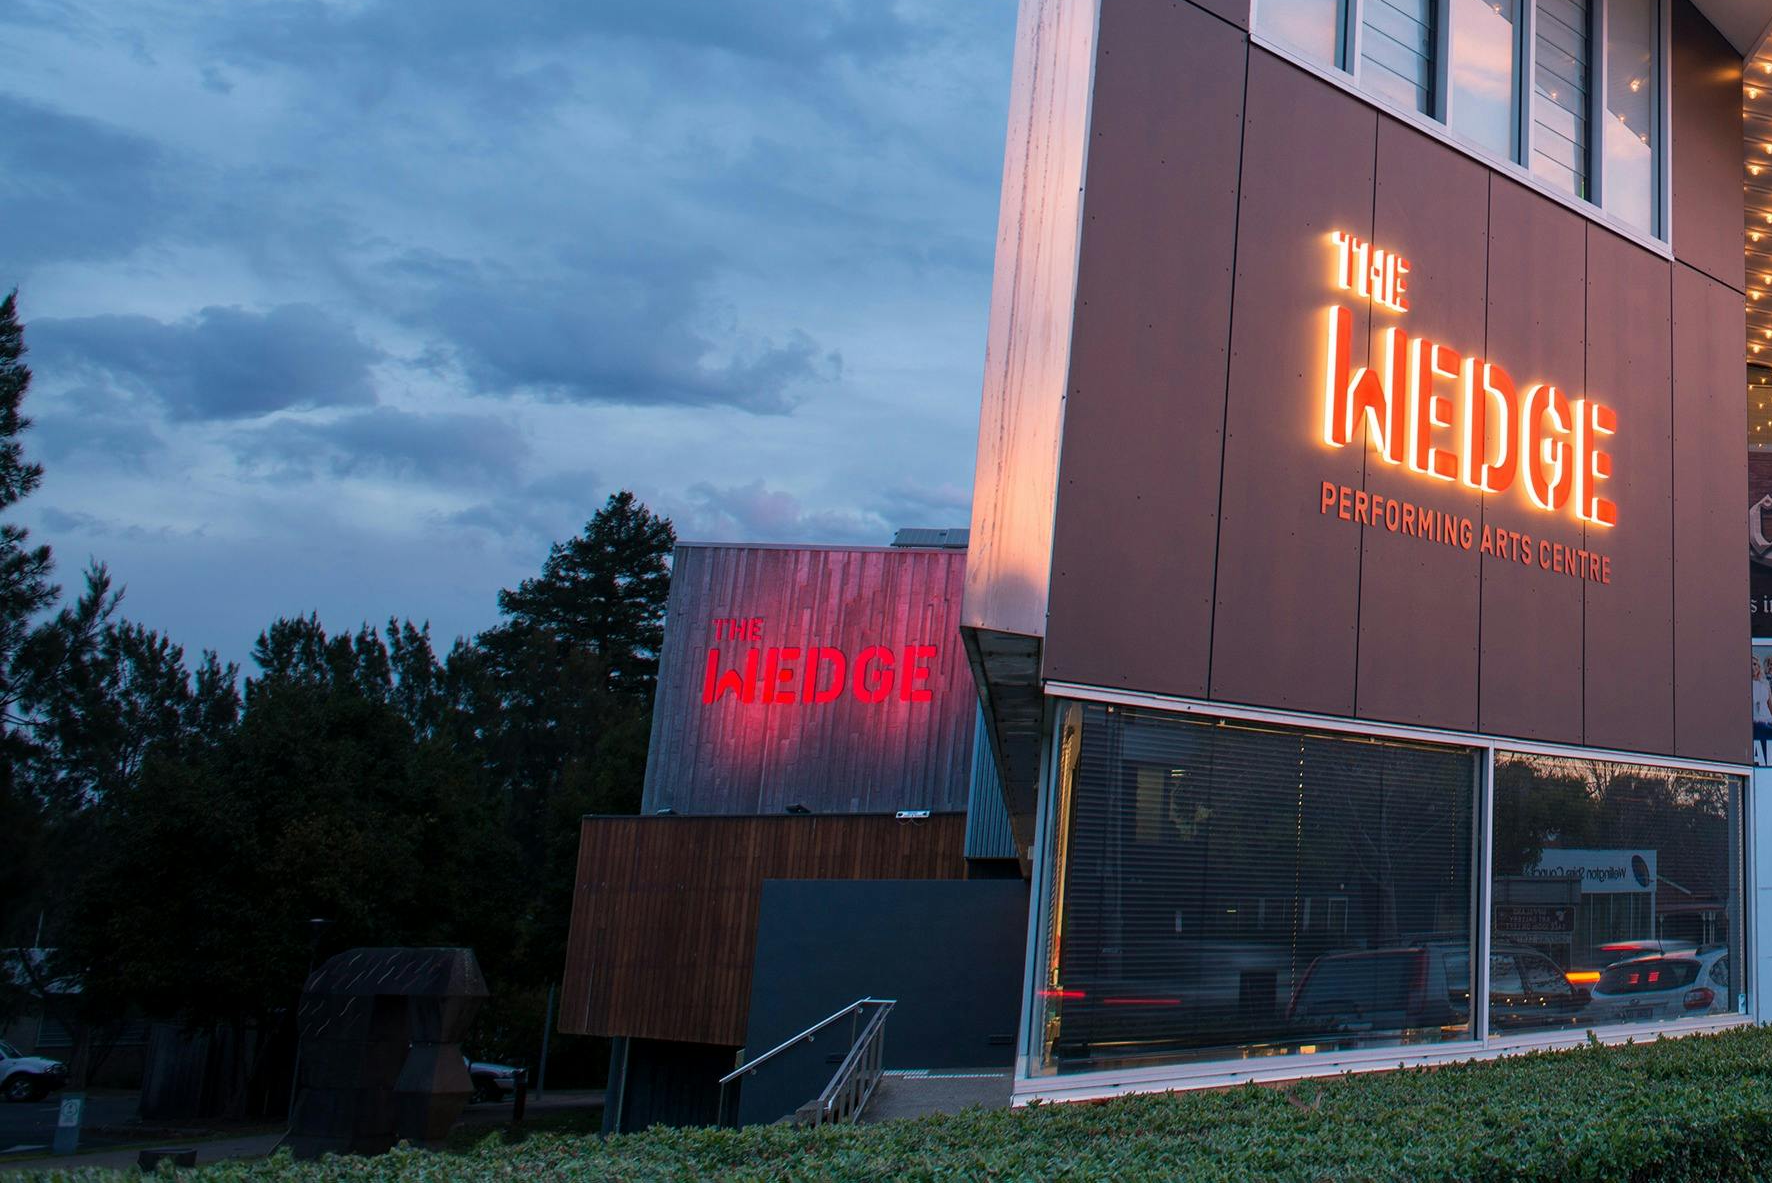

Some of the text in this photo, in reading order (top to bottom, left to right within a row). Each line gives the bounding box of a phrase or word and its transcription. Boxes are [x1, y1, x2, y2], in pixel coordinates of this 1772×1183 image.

[1331, 230, 1411, 313] THE
[1323, 304, 1617, 527] WEDGE
[1320, 480, 1611, 584] PERFORMING ARTS CENTRE
[712, 617, 764, 642] THE
[702, 645, 938, 706] WEDGE
